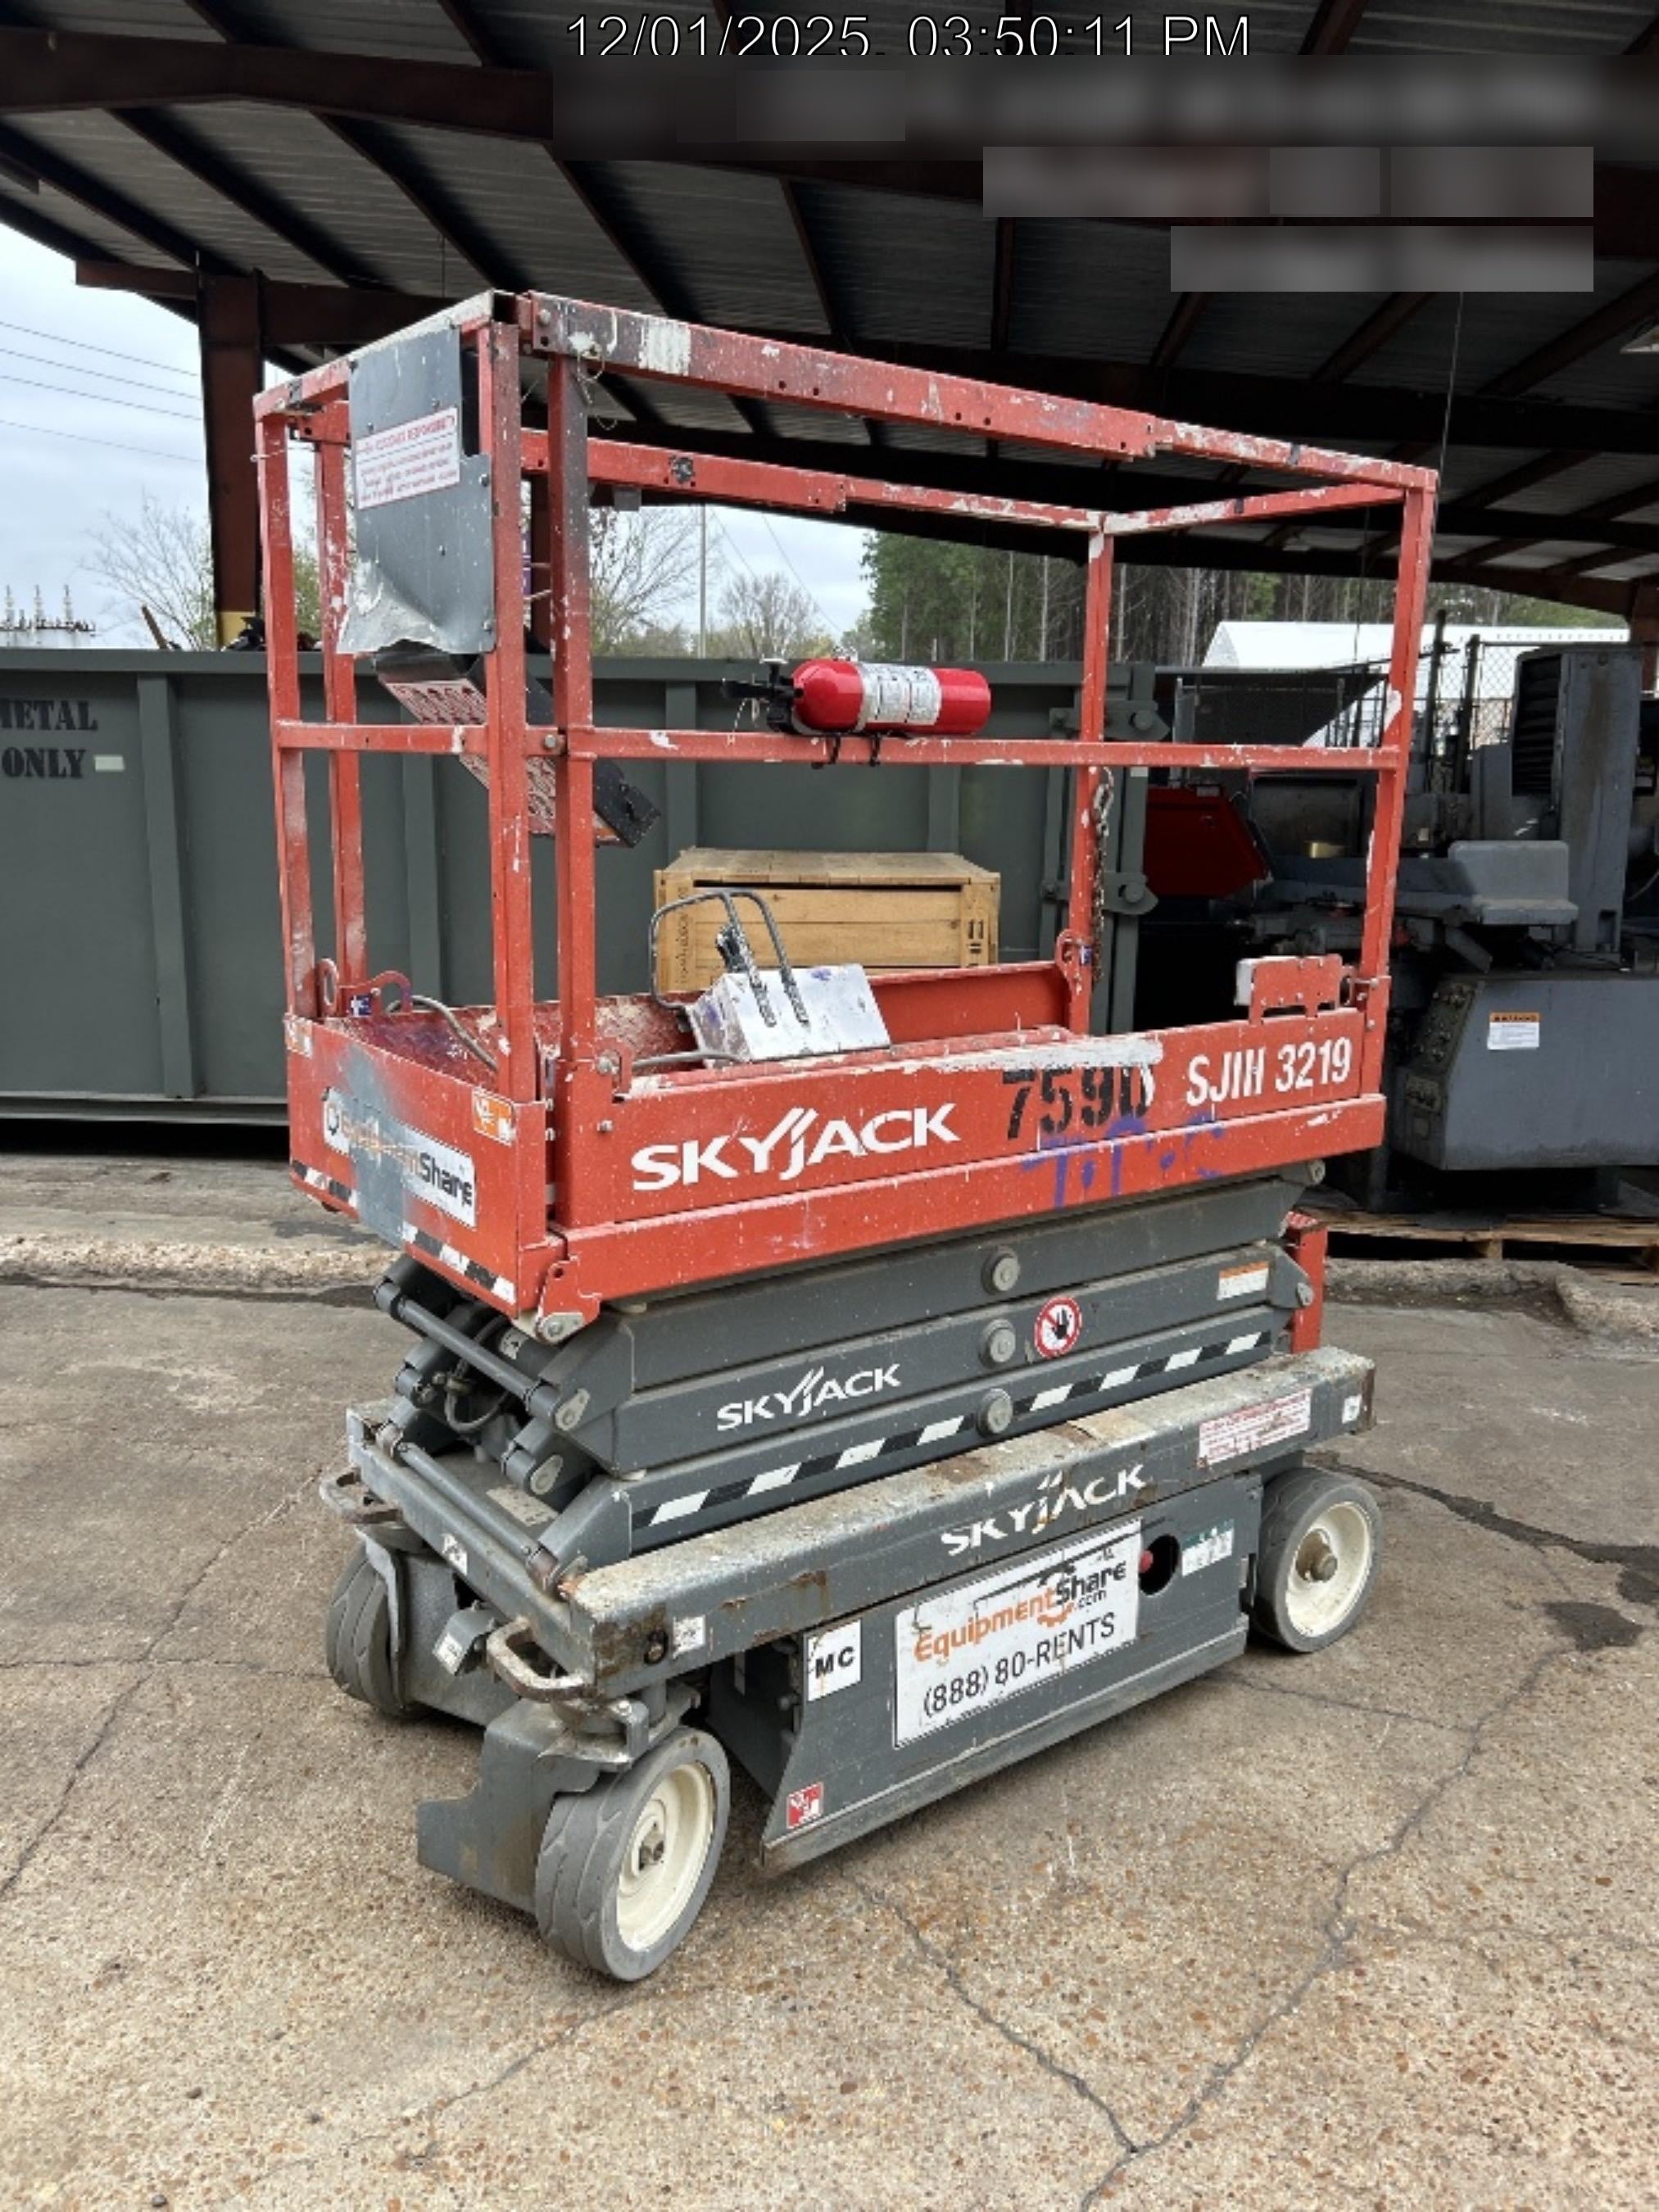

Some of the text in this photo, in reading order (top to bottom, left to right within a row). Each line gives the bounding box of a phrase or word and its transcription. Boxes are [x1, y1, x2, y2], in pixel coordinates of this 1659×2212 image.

[2, 746, 86, 778] ONLY
[1275, 1036, 1353, 1093] 3219
[630, 1102, 962, 1191] SKYJACK
[716, 1362, 901, 1431] SKYJACK
[941, 1463, 1147, 1557] SKYJACK
[913, 1560, 1127, 1662] EquipmentShare
[923, 1611, 1115, 1718] (888) 80-RENTS
